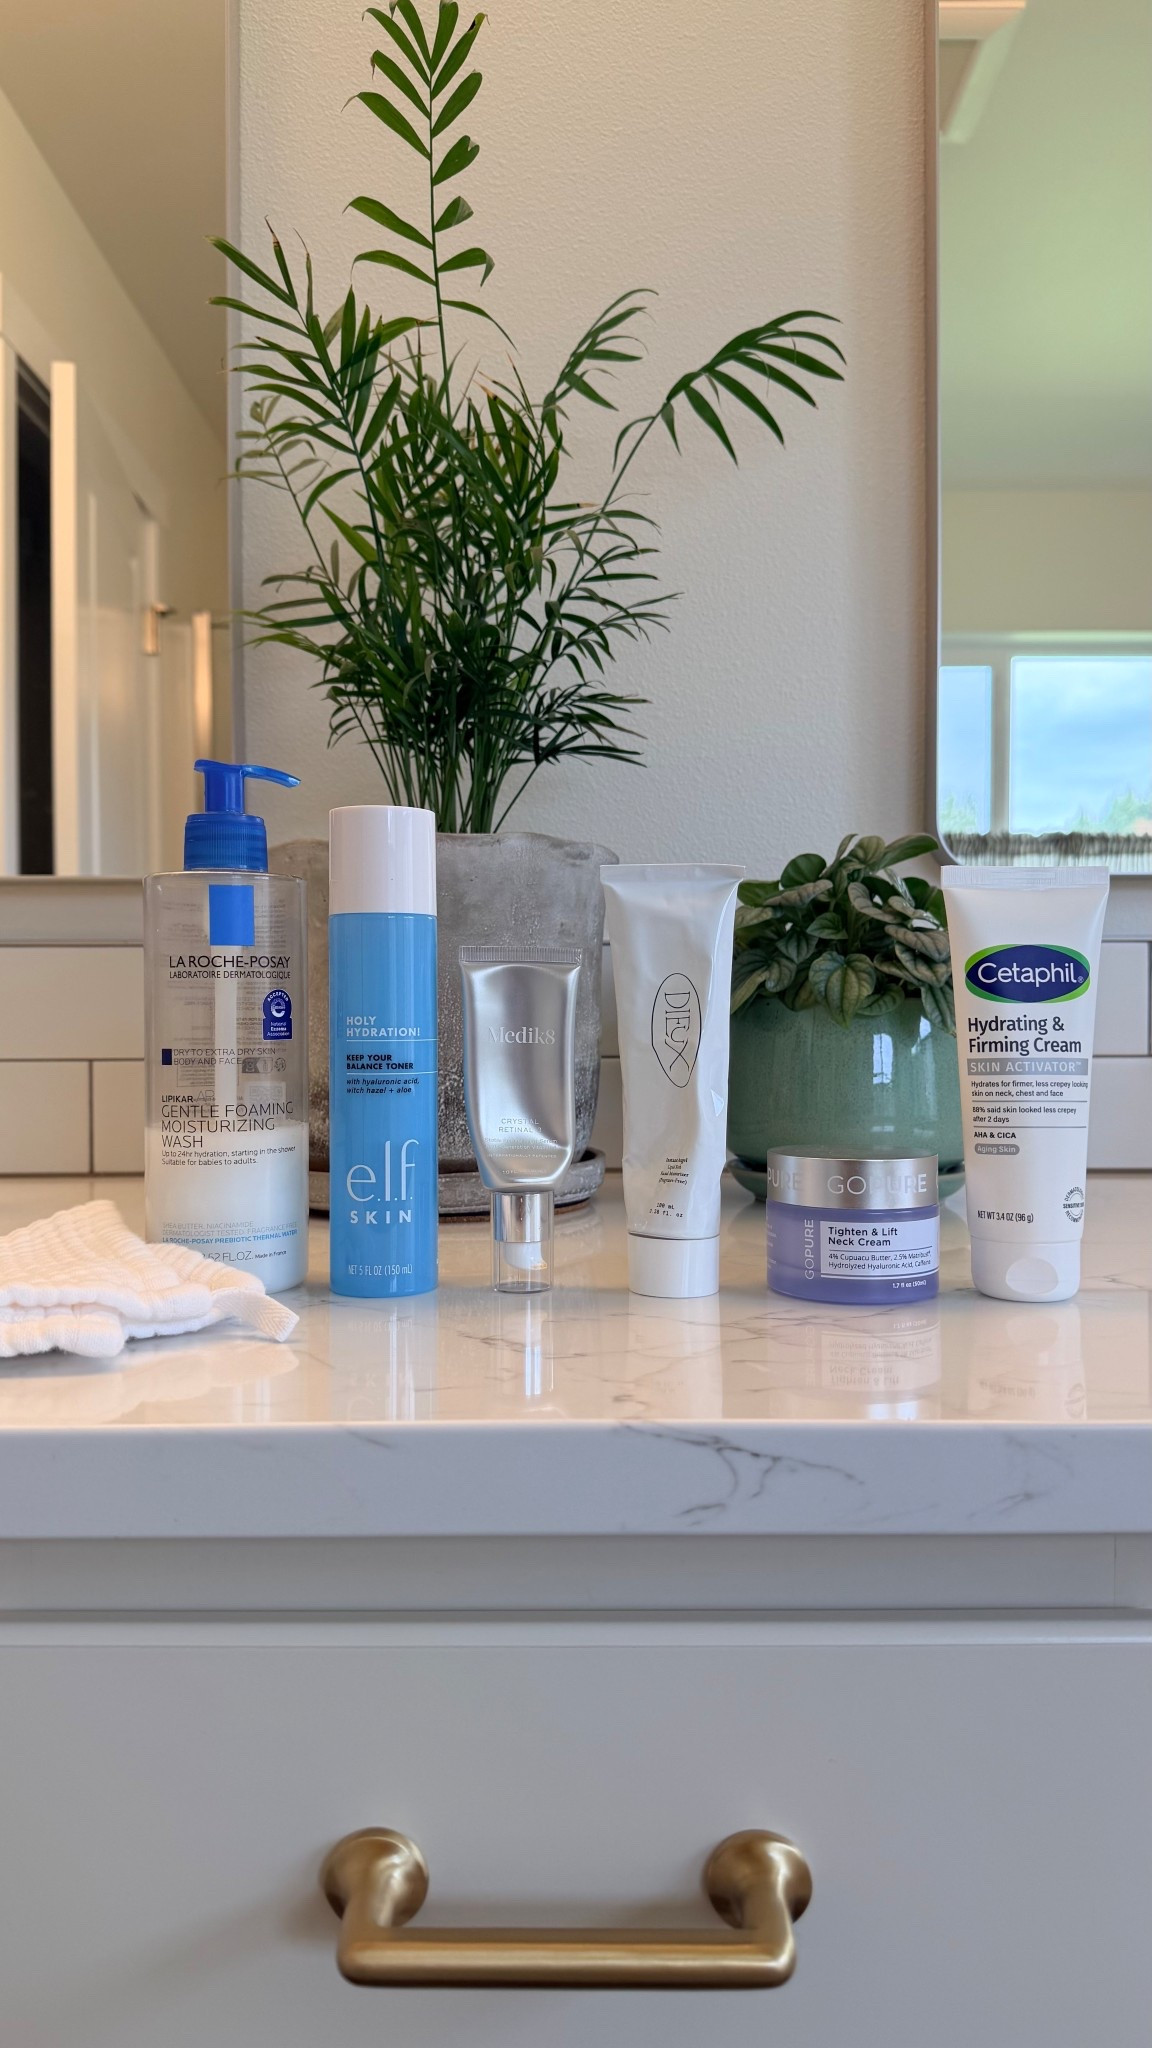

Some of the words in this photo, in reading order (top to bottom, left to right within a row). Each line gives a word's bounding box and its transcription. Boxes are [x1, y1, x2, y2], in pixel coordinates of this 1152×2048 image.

[169, 956, 186, 968] LA
[188, 956, 291, 968] ROCHE-POSAY
[170, 970, 220, 979] LABORATOIRE
[224, 971, 290, 979] DERMATOLOGIQUE
[346, 1016, 376, 1025] HOLY
[968, 1014, 1048, 1035] Hydrating
[1052, 1016, 1064, 1031] &
[346, 1028, 420, 1037] HYDRATION!
[489, 1026, 555, 1044] Medik8
[664, 991, 690, 1072] DIEUX
[969, 1036, 1029, 1056] Firming
[1034, 1038, 1082, 1053] Cream
[970, 1062, 1000, 1072] SKIN
[362, 1078, 401, 1086] hyaluronic
[971, 1081, 999, 1089] Hydrates
[1072, 1081, 1088, 1089] looking
[162, 1104, 219, 1118] GENTLE
[226, 1102, 293, 1117] FOAMING
[162, 1118, 274, 1133] MOISTURIZING
[162, 1135, 203, 1148] WASH
[827, 1173, 927, 1195] GOPURE
[350, 1210, 412, 1224] SKIN
[978, 1210, 986, 1219] NET
[987, 1211, 995, 1220] WT
[996, 1212, 1005, 1221] 3.4
[1006, 1213, 1014, 1222] OZ
[1015, 1212, 1025, 1223] (96
[1027, 1213, 1034, 1224] g)
[248, 1225, 285, 1234] FRAGRANCE
[828, 1227, 868, 1236] Tighten
[871, 1228, 878, 1236] &
[882, 1228, 898, 1236] Lift
[253, 1232, 281, 1241] THERMAL
[828, 1237, 854, 1245] Neck
[858, 1238, 890, 1246] Cream
[805, 1219, 814, 1280] GOPURE
[349, 1265, 357, 1275] NET
[359, 1266, 363, 1275] 5
[365, 1266, 372, 1275] FL
[374, 1266, 382, 1275] OZ
[384, 1265, 400, 1275] (150
[402, 1264, 413, 1274] mL)
[828, 1262, 866, 1270] Hydrolyzed
[868, 1263, 900, 1271] Hyaluronic
